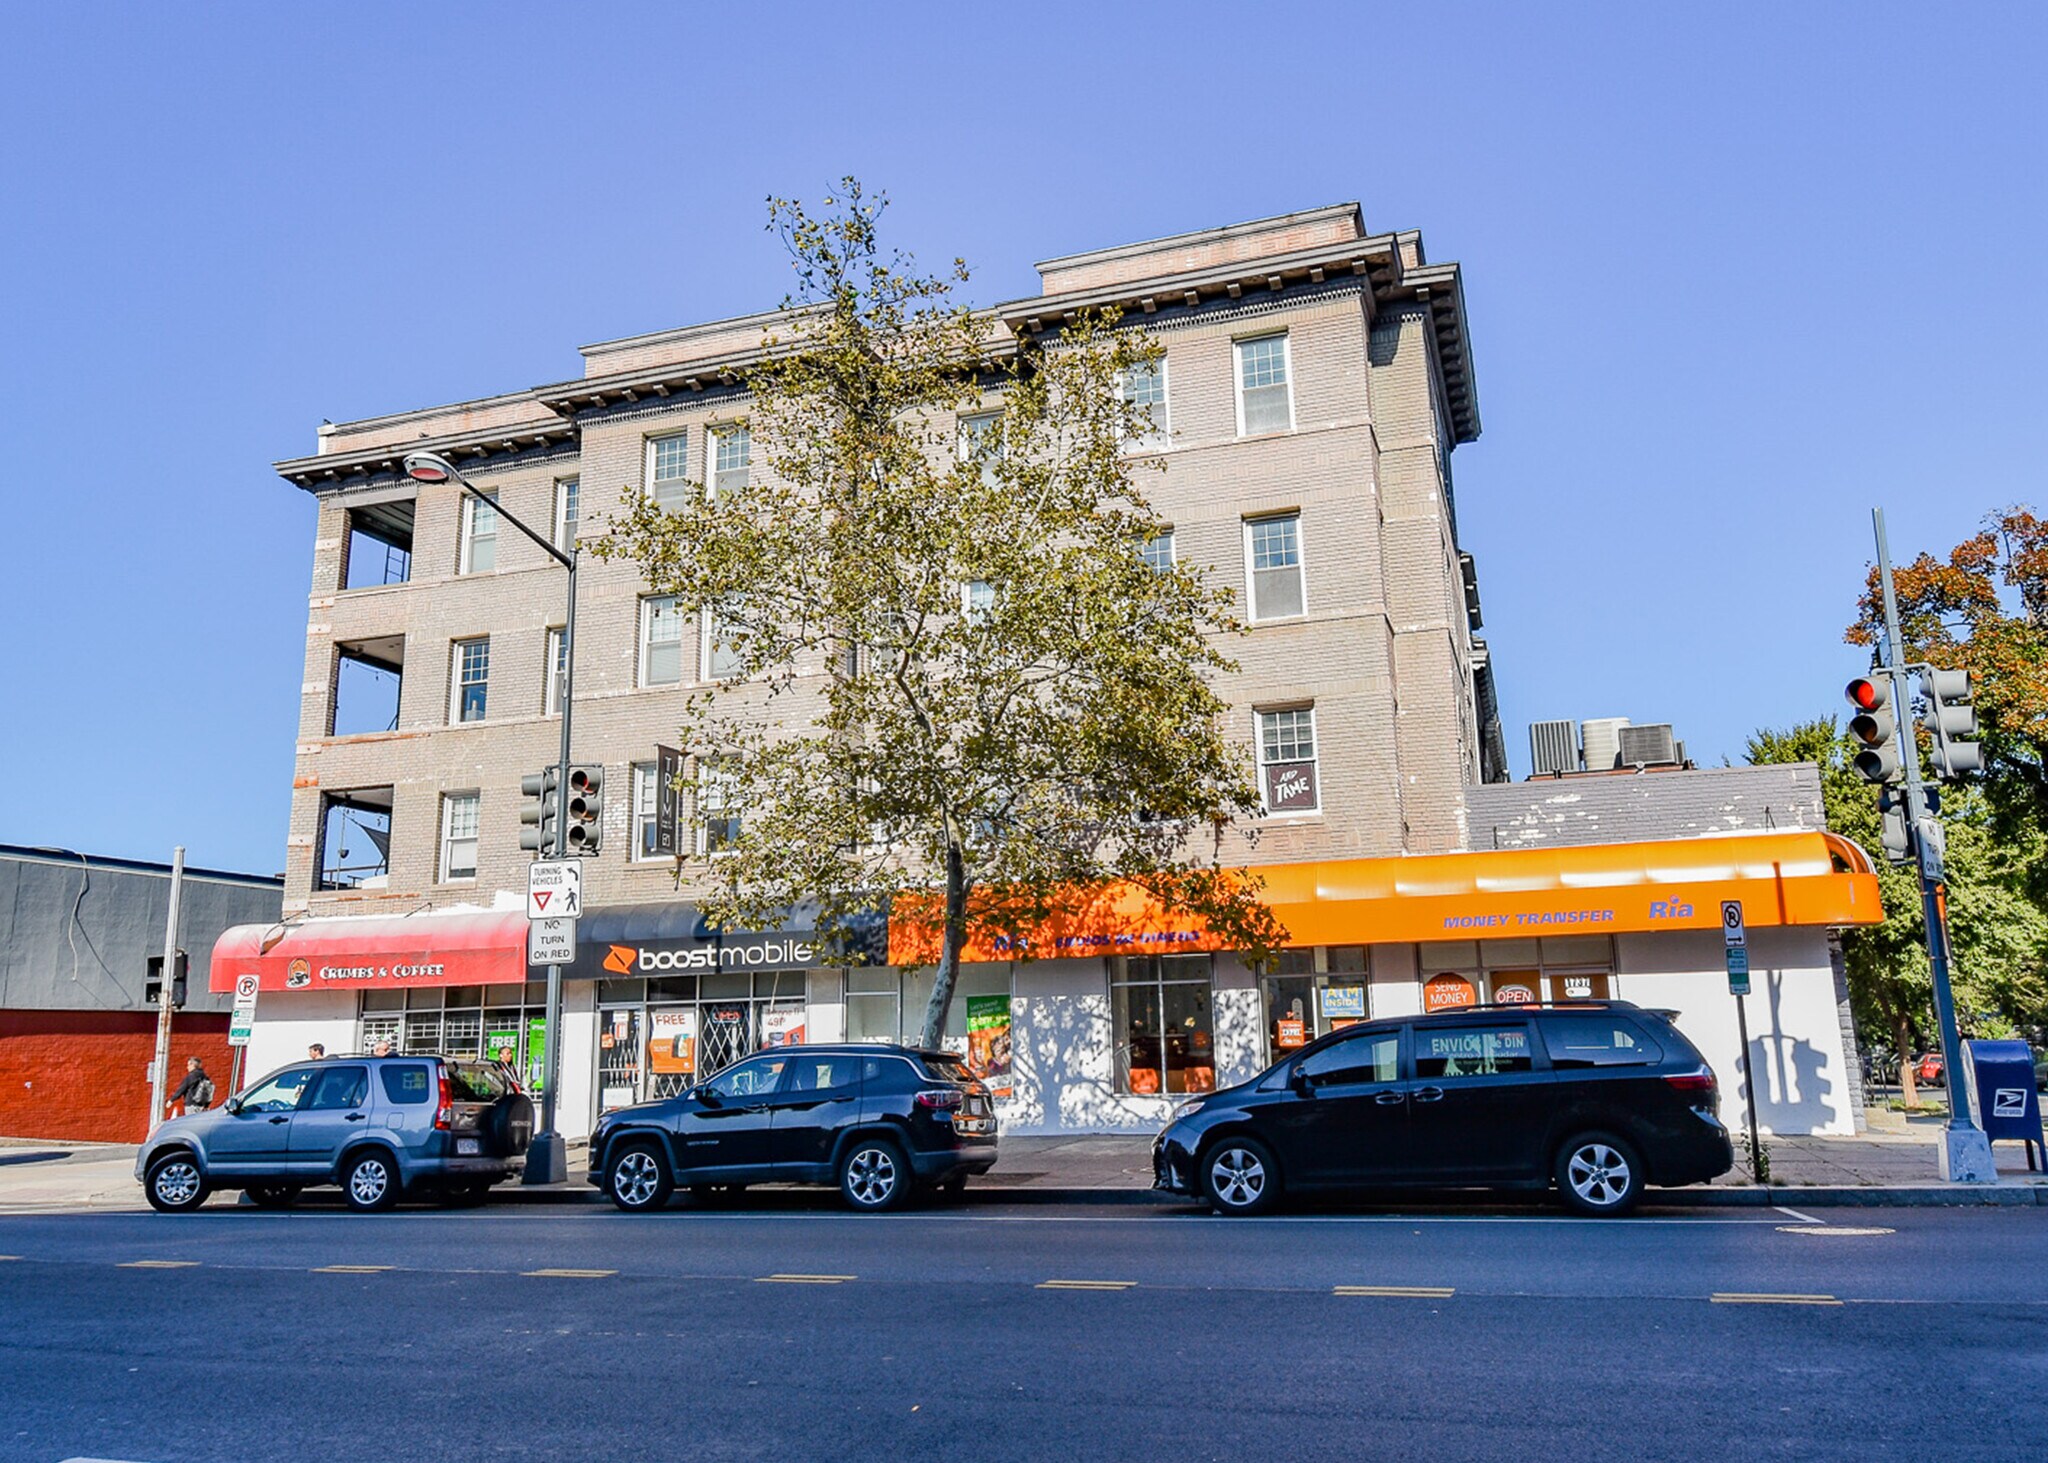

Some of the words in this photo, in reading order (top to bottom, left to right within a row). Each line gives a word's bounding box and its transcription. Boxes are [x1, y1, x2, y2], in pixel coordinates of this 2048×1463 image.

[661, 755, 673, 819] TRIM
[1274, 776, 1310, 804] TAME
[533, 866, 563, 877] TURNING
[531, 876, 564, 886] VEHICLES
[1649, 894, 1694, 919] Ria
[544, 919, 561, 930] NO
[1443, 914, 1509, 929] MONEY
[1515, 909, 1615, 926] TRANSFER
[539, 935, 566, 945] TURN
[533, 950, 548, 960] ON
[550, 948, 571, 959] RED
[377, 967, 388, 977] &
[1326, 986, 1359, 998] ATM
[1435, 982, 1462, 993] SEND
[1326, 998, 1359, 1007] INSIDE
[1430, 992, 1468, 1005] MONEY
[1496, 991, 1533, 1003] OPEN
[655, 1014, 686, 1026] FREE
[490, 1035, 517, 1048] FREE
[1431, 1037, 1480, 1053] ENVIO
